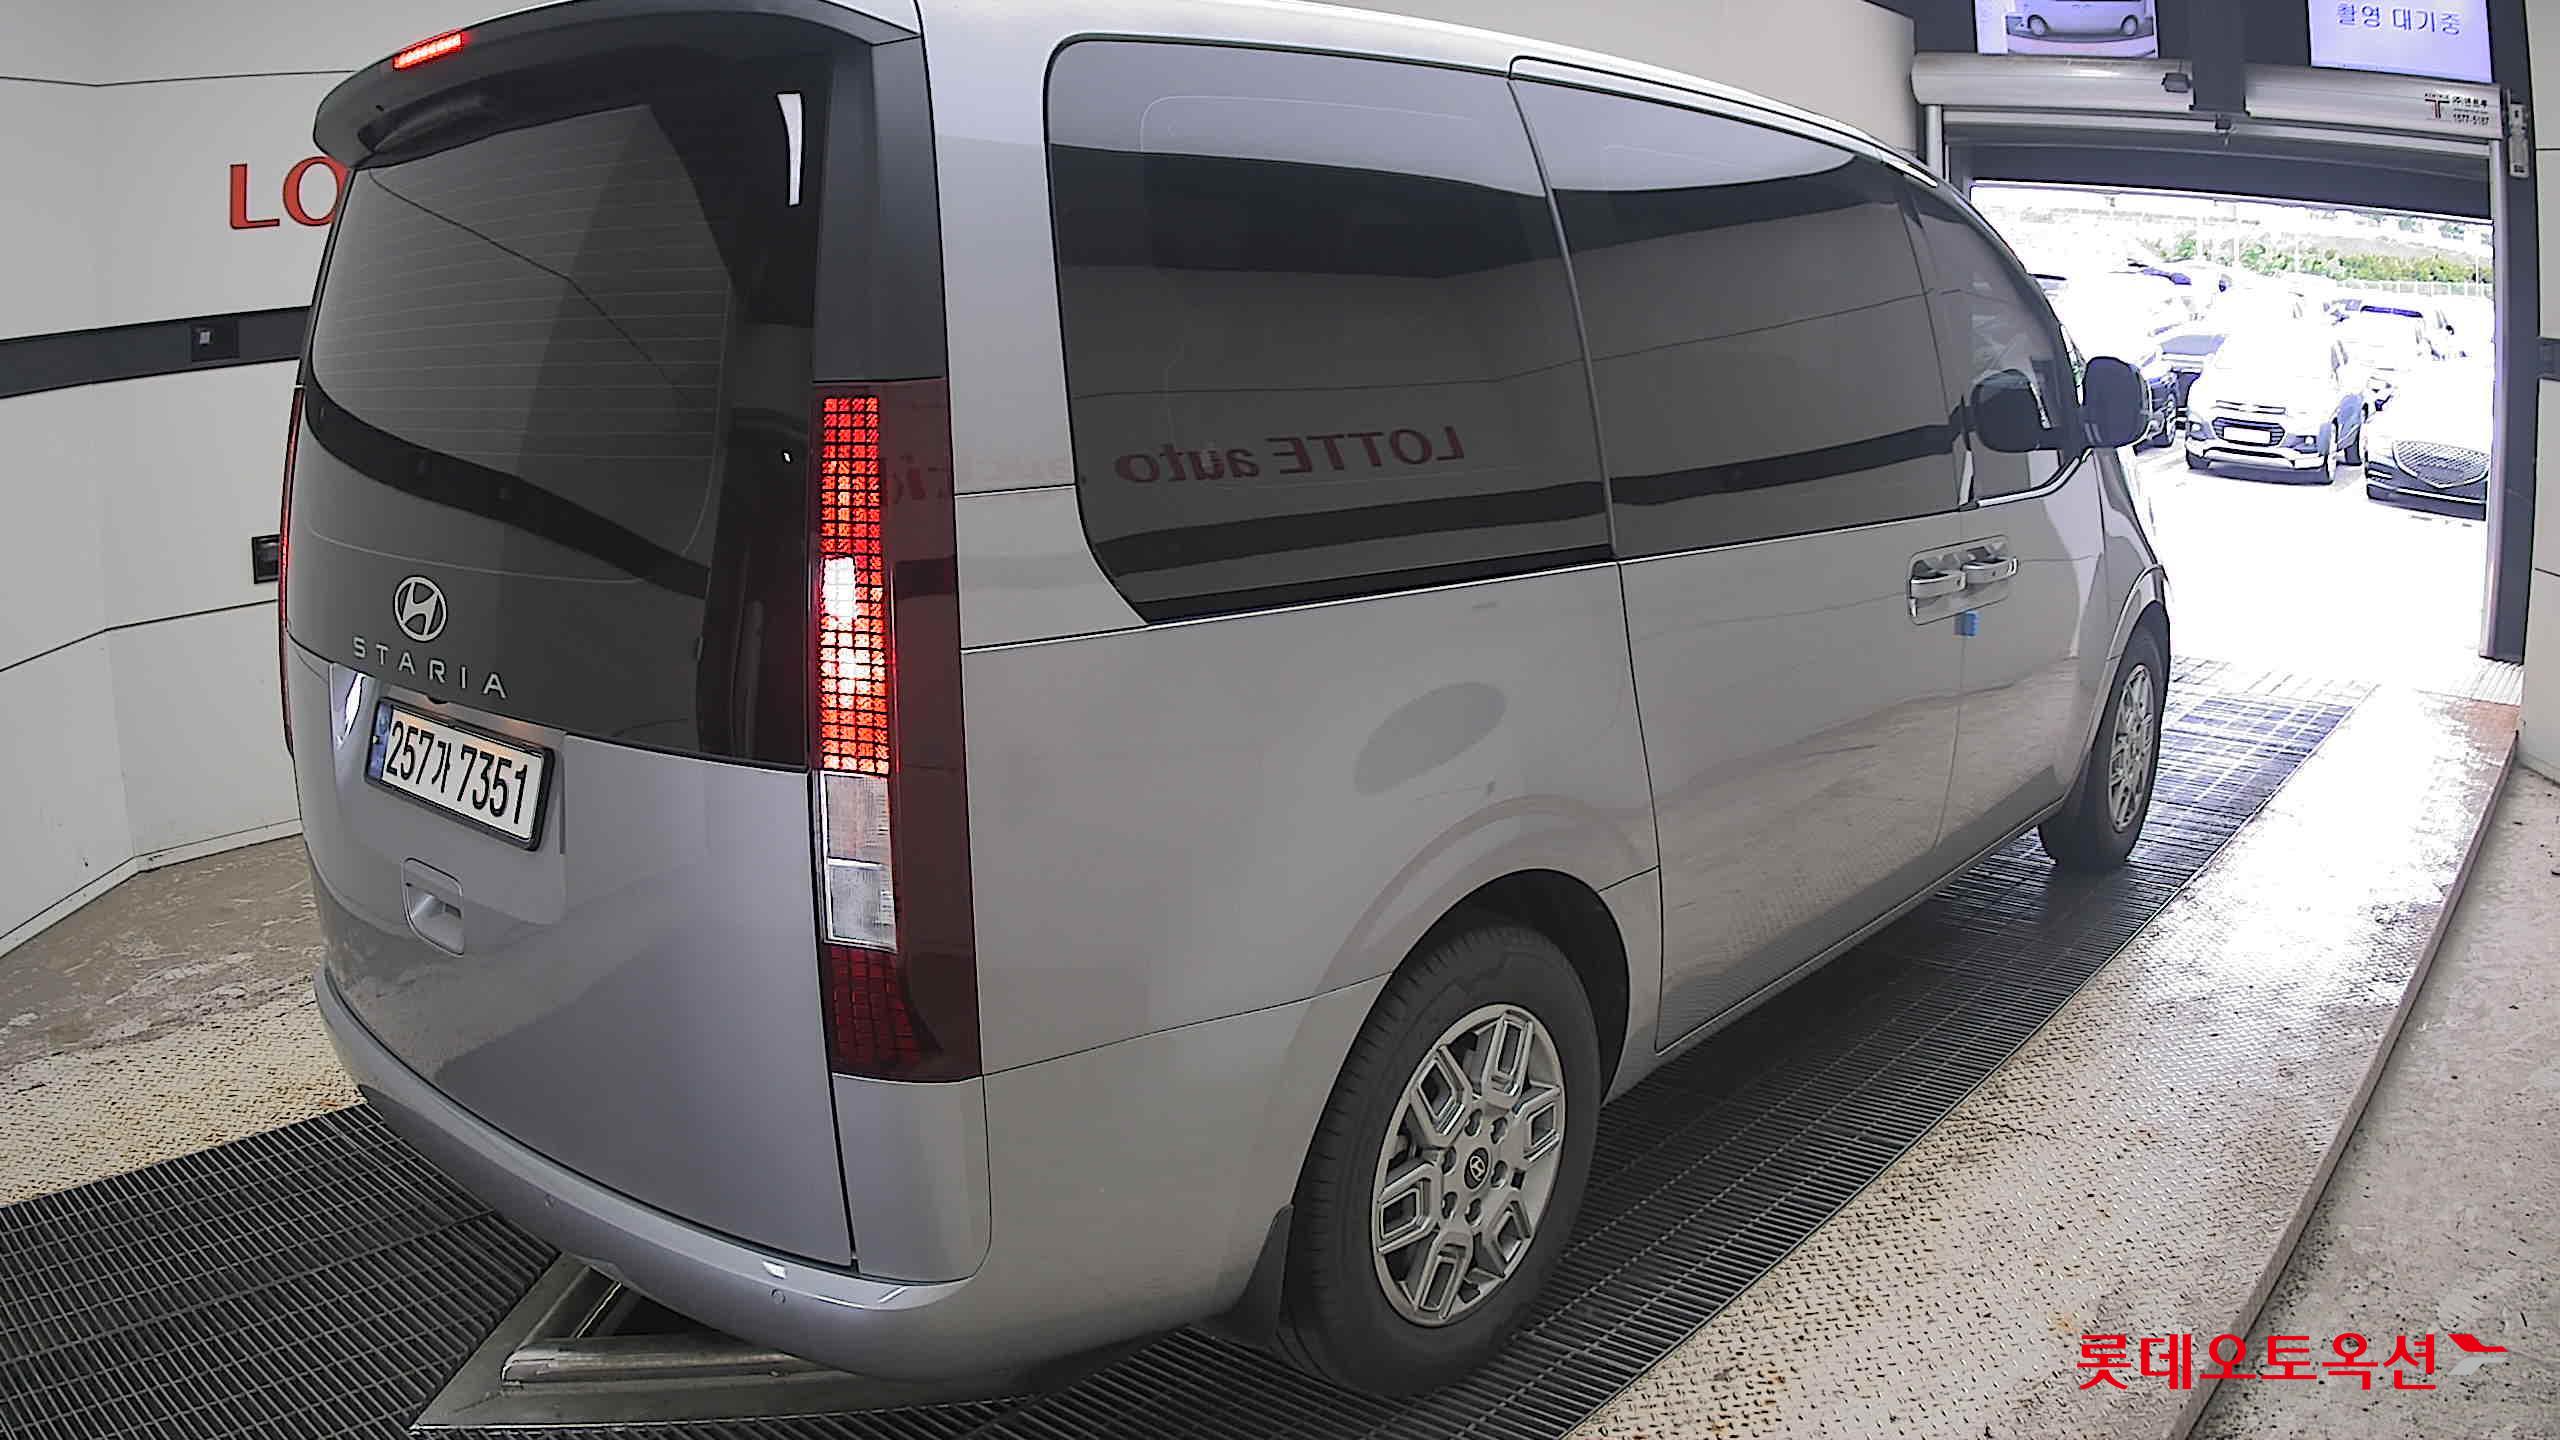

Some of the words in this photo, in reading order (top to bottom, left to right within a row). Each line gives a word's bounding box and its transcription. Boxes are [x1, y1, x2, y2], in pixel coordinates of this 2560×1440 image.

[2337, 3, 2382, 28] 촬영
[2392, 8, 2461, 36] 대기중
[352, 636, 508, 701] STARIA
[456, 743, 530, 826] 7351
